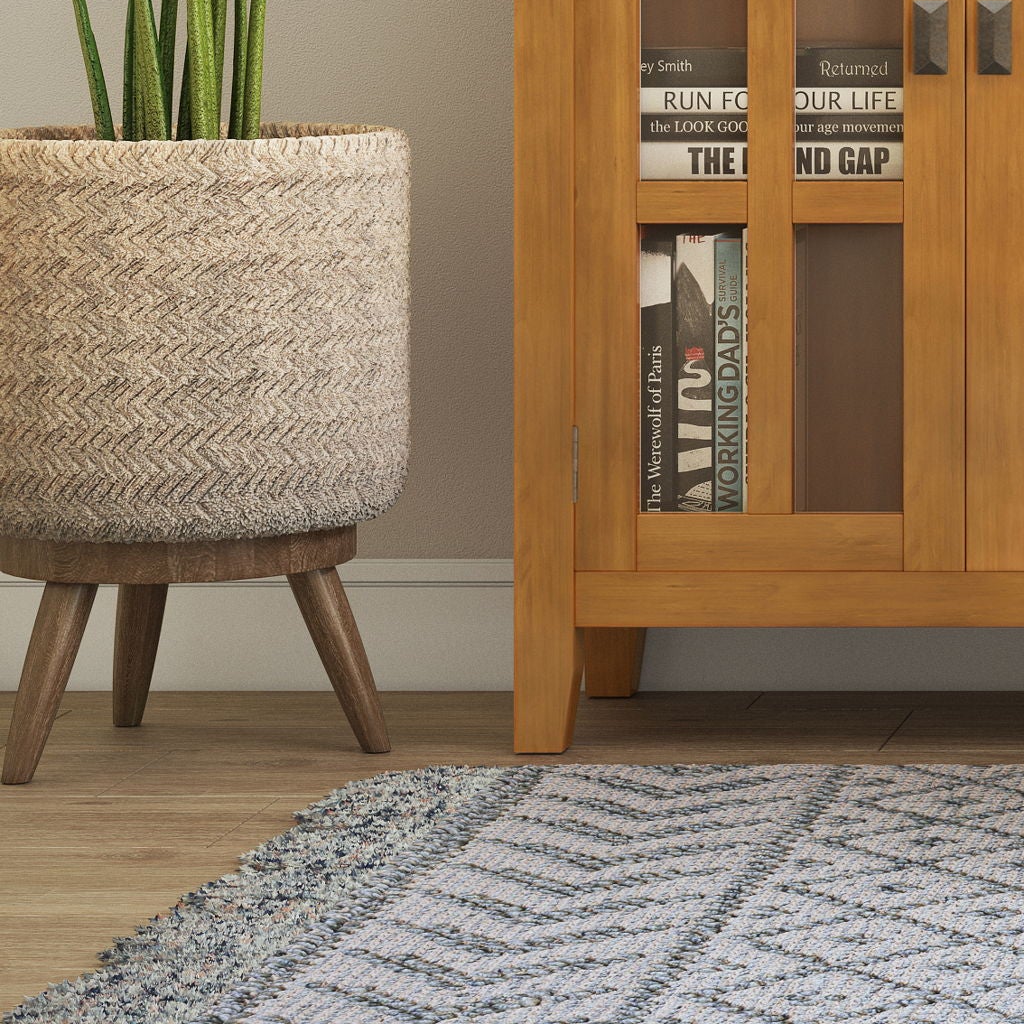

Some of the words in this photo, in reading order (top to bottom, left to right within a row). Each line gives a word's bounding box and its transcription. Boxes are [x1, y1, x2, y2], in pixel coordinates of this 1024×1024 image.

[641, 62, 654, 75] ey
[658, 59, 692, 72] Smith
[819, 59, 888, 77] Returned
[664, 91, 712, 110] RUN
[722, 91, 747, 110] FO
[795, 91, 842, 110] OUR
[852, 91, 897, 110] LIFE
[651, 120, 670, 133] the
[675, 120, 714, 133] LOOK
[718, 120, 747, 133] GOO
[795, 123, 814, 133] our
[817, 123, 838, 135] age
[843, 122, 904, 133] movemen
[688, 146, 735, 175] THE
[838, 146, 890, 175] GAP
[718, 259, 727, 302] SURVIVAL
[730, 275, 738, 302] GUIDE
[647, 345, 662, 382] Paris
[647, 386, 661, 404] of
[647, 405, 661, 480] Werewolf
